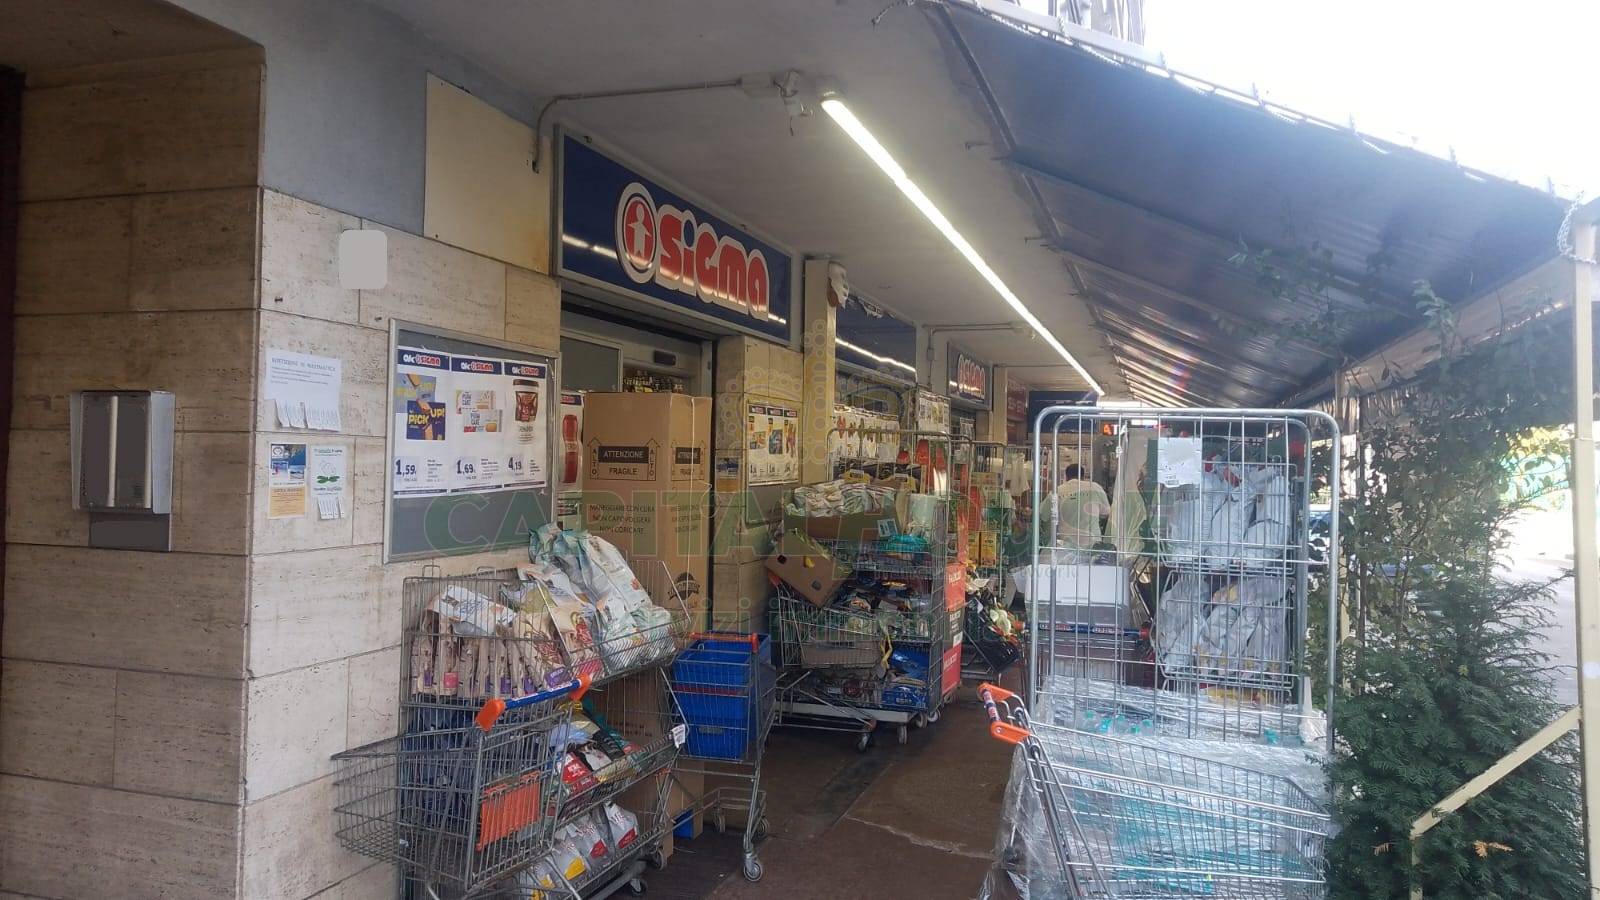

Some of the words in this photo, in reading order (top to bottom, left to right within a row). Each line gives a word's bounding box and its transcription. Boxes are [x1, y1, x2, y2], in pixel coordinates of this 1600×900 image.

[430, 408, 445, 417] UP!
[408, 414, 429, 424] PICK
[603, 450, 645, 459] ATTENZIONE
[609, 467, 638, 476] FRAGILE
